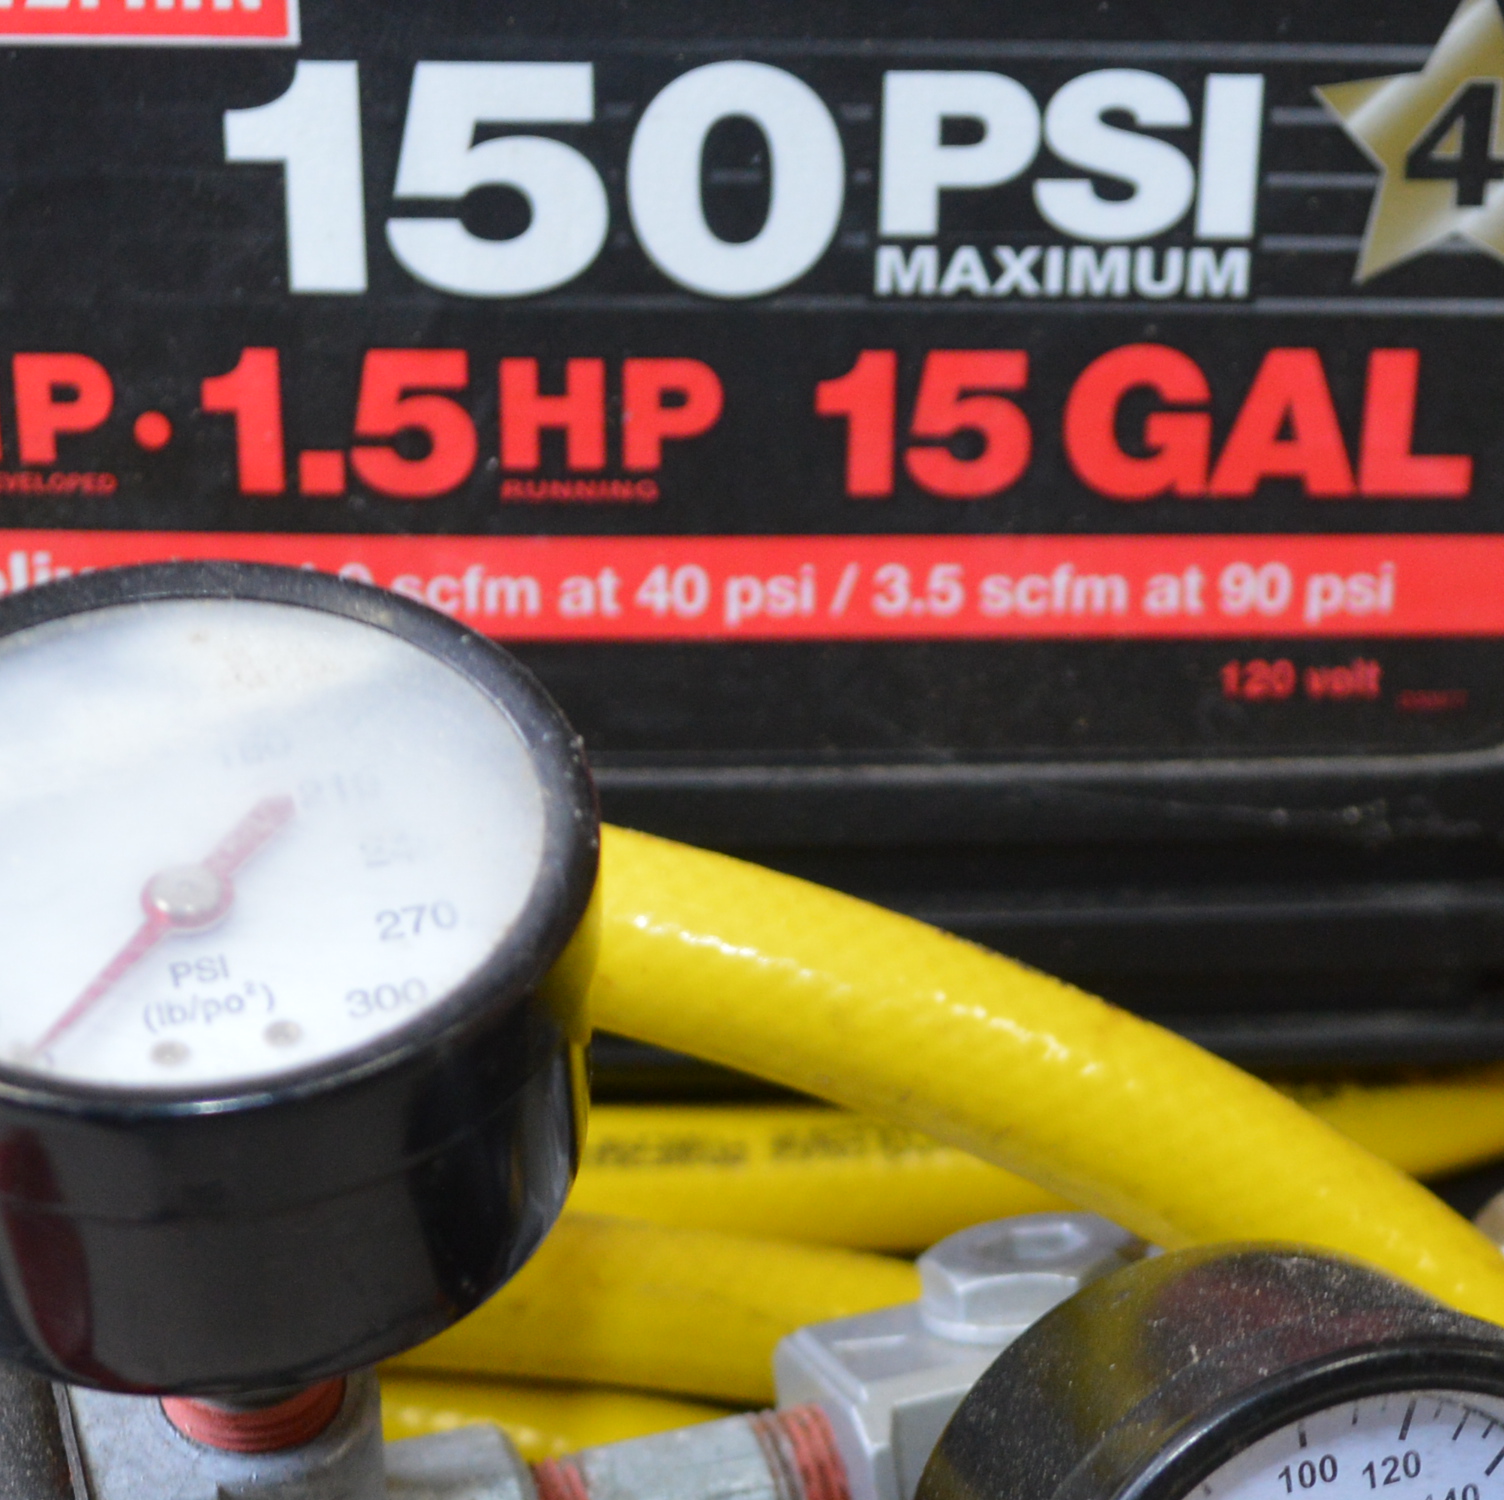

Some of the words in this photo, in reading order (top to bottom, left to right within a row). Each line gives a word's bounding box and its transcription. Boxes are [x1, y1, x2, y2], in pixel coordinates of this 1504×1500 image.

[225, 59, 845, 299] 150
[878, 68, 1265, 241] PSI
[874, 245, 1251, 299] MAXIMUM
[200, 345, 479, 498] 1.5
[499, 357, 724, 472] HP
[814, 348, 1032, 498] 15
[1063, 343, 1474, 499] GAL
[500, 477, 660, 500] RUNNING
[559, 566, 623, 618] at
[635, 562, 710, 619] 40
[724, 562, 816, 630] psi
[872, 562, 966, 619] 3.5
[979, 562, 1129, 618] scfm
[1141, 563, 1205, 617] at
[1219, 561, 1293, 617] 90
[1303, 560, 1394, 626] psi
[1222, 658, 1296, 699] 120
[374, 899, 459, 943] 270
[168, 954, 231, 989] PSI
[344, 976, 428, 1020] 300
[1276, 1453, 1339, 1496] 100
[1360, 1449, 1422, 1491] 120
